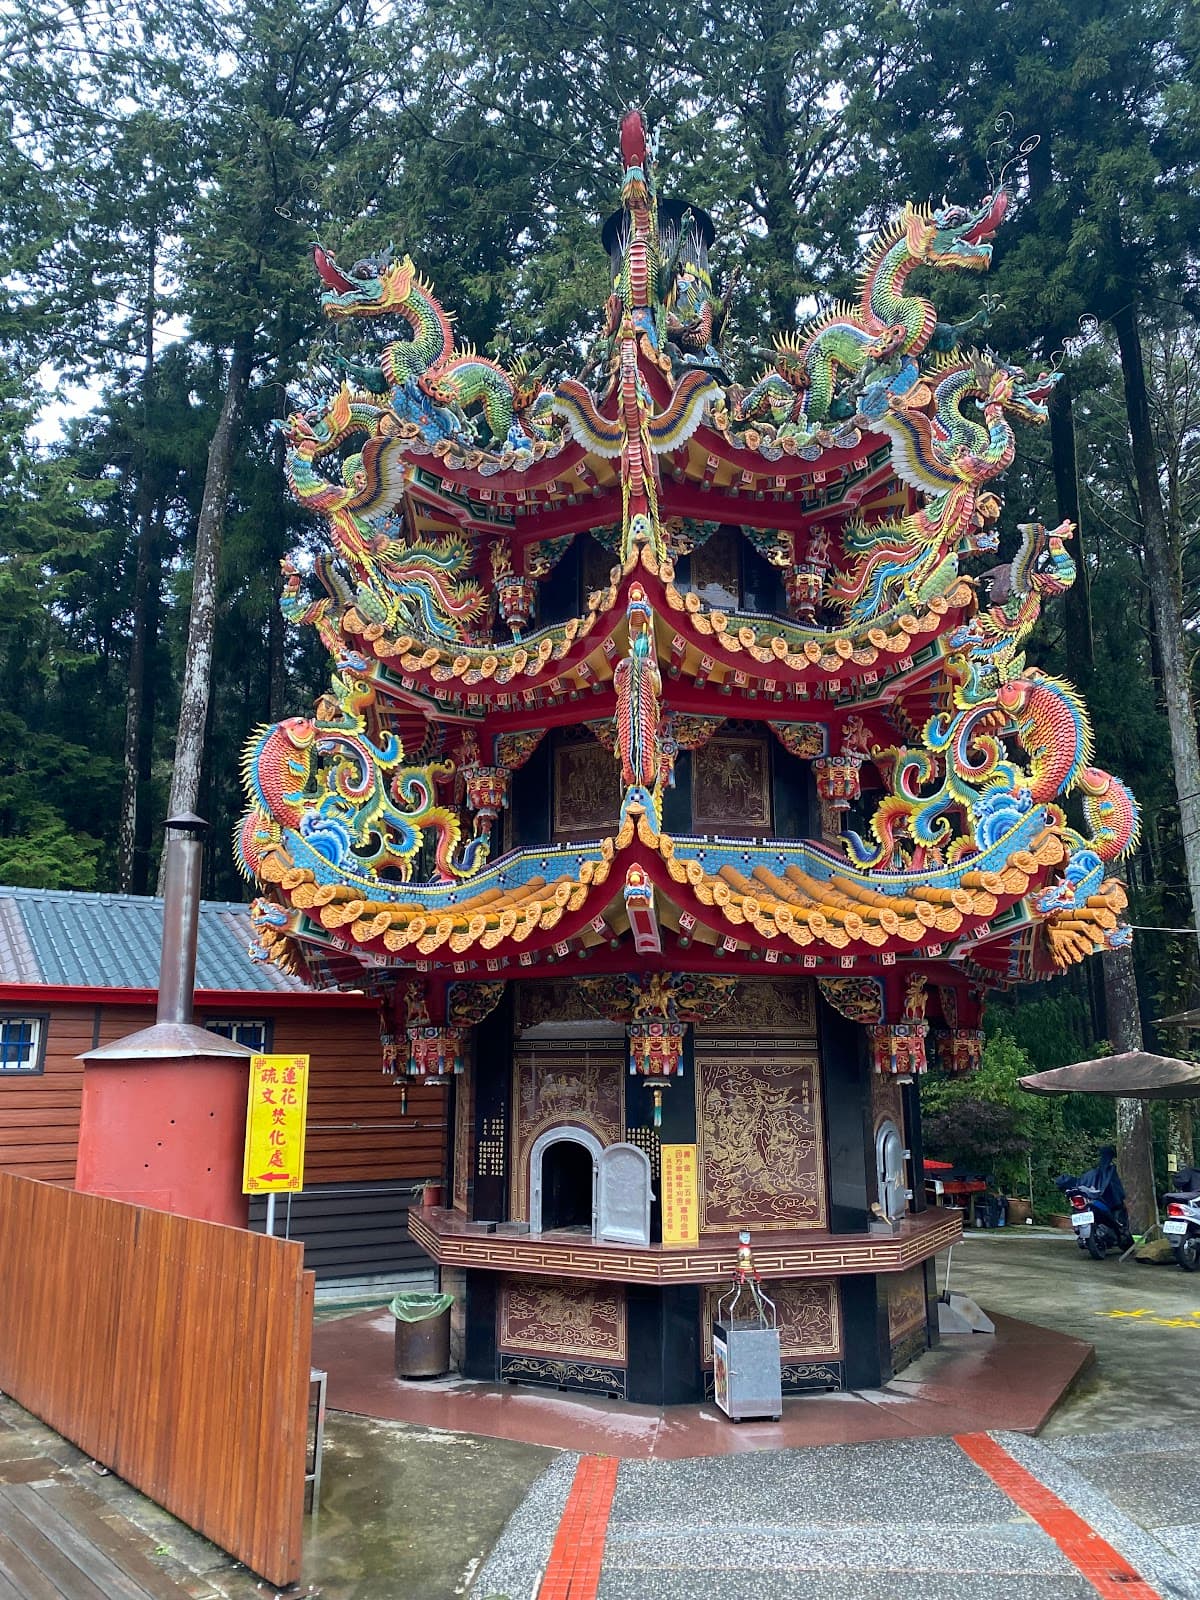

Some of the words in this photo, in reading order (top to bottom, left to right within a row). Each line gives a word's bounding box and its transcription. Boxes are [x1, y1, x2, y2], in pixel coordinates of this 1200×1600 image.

[260, 1067, 278, 1105] 疏文
[281, 1067, 298, 1105] 蓮花
[267, 1108, 286, 1168] 焚化處
